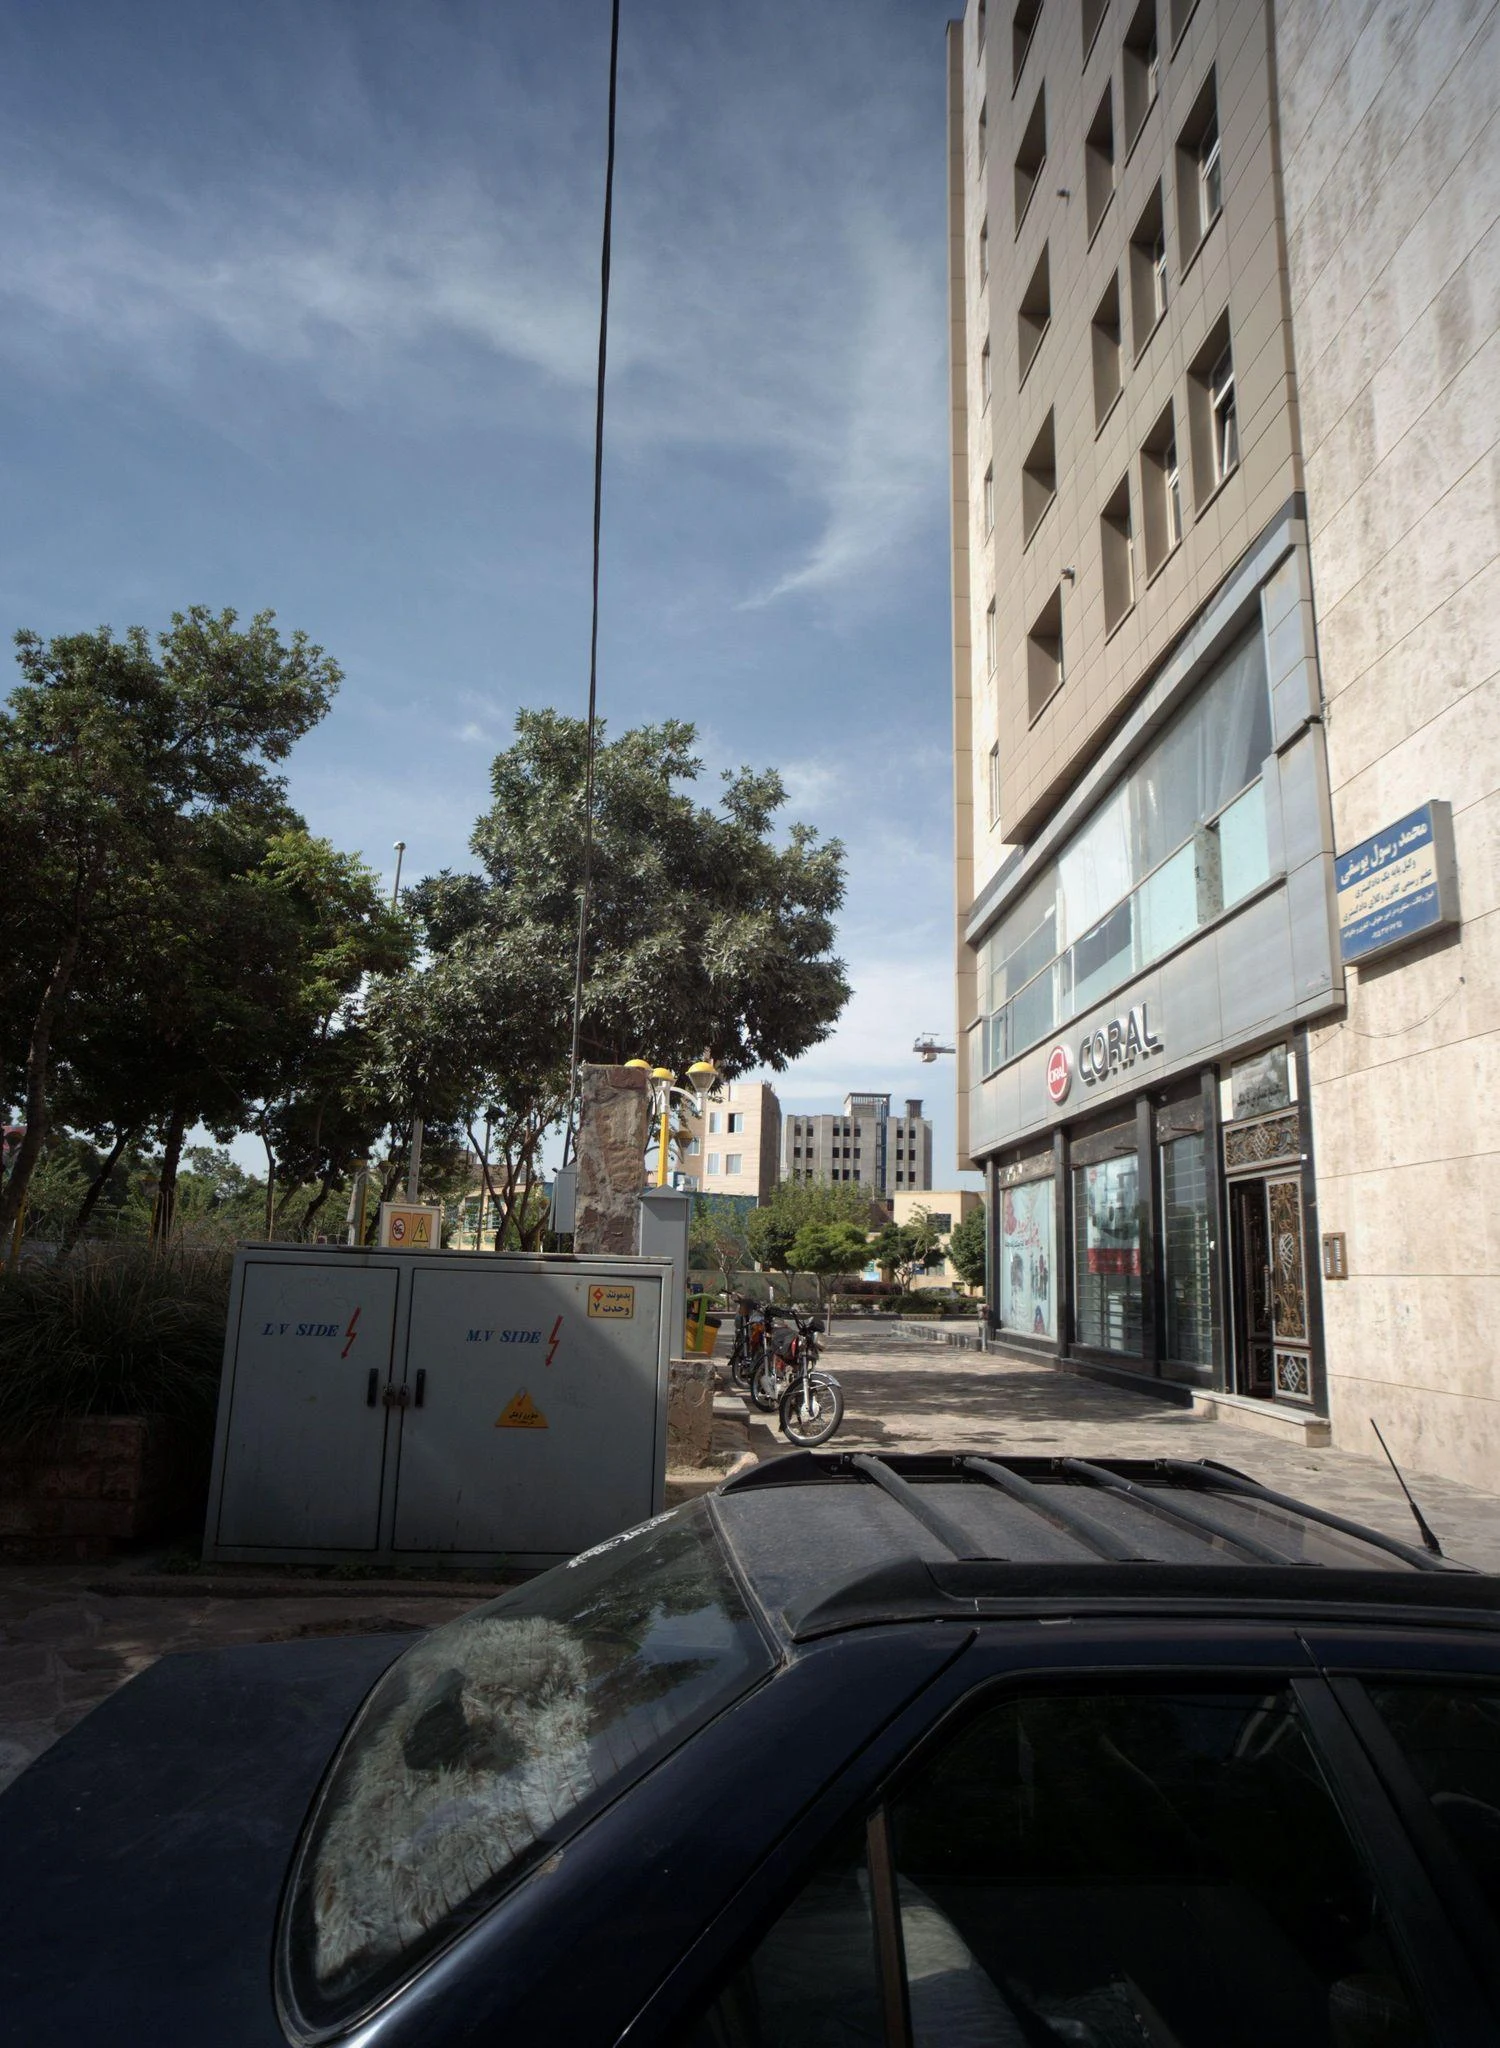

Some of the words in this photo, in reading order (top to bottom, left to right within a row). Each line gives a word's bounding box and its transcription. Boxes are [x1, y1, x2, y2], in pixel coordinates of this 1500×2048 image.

[1398, 823, 1428, 847] محمد
[1370, 842, 1398, 867] رسول
[1340, 854, 1370, 885] یوسفی
[1079, 1001, 1160, 1082] CORAL
[602, 1304, 630, 1316] وحدت
[295, 1323, 340, 1337] SIDE
[466, 1328, 495, 1342] M.V
[499, 1329, 542, 1344] SIDE
